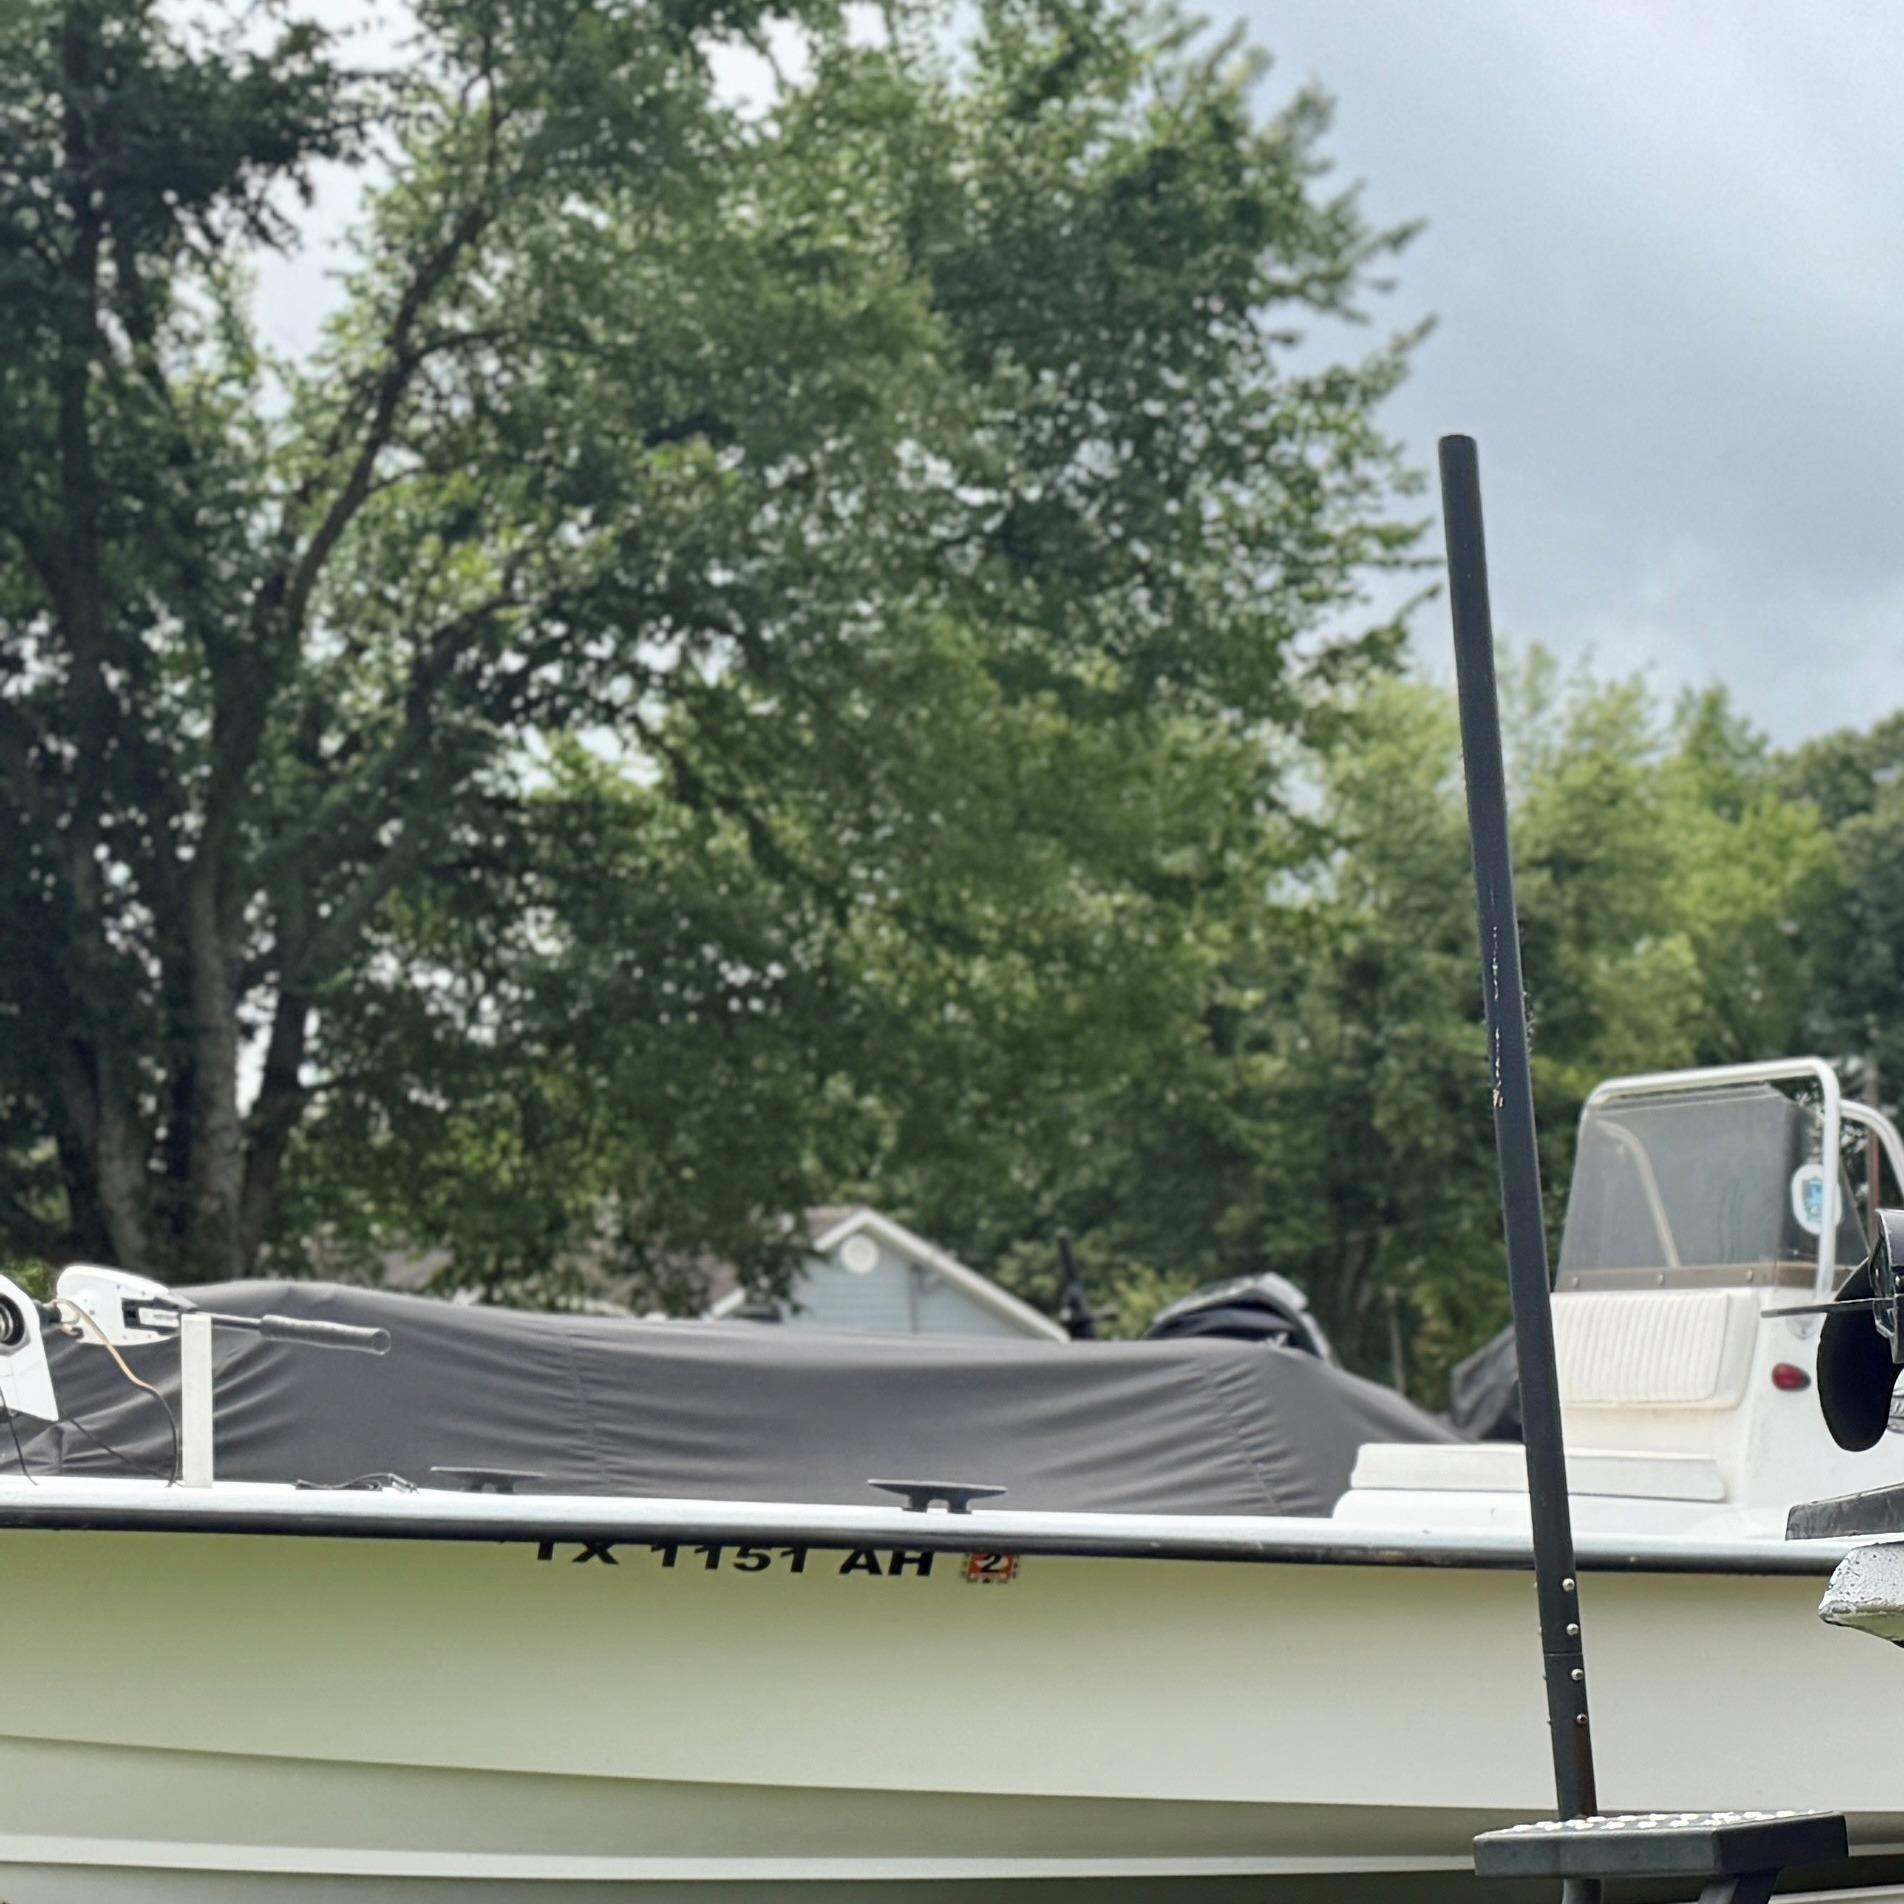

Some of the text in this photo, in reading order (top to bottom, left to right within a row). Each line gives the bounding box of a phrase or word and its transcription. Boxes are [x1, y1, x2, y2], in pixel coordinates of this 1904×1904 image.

[536, 1541, 934, 1577] TX 1151 AH
